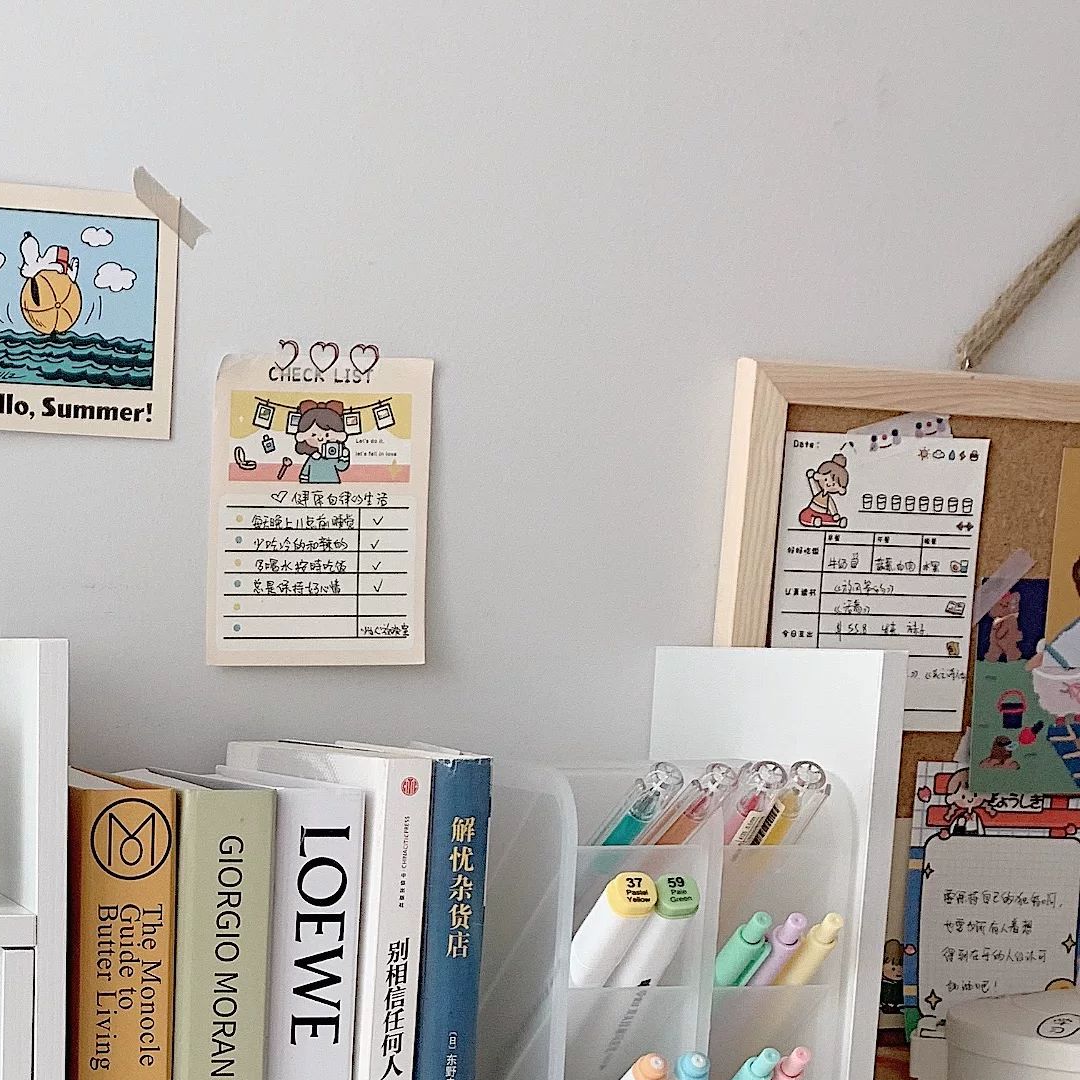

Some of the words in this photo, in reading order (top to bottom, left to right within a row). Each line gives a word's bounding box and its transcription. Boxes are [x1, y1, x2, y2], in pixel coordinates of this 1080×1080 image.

[269, 366, 325, 383] CHECK
[334, 367, 374, 384] LIST
[41, 396, 153, 423] Summer!
[793, 439, 820, 450] Date:
[214, 835, 244, 963] GIORGIO
[446, 816, 476, 959] 解忧杂货店
[625, 877, 643, 888] 37
[667, 876, 685, 888] 59
[96, 903, 119, 981] Butter
[118, 903, 141, 978] Guide
[141, 903, 163, 950] The
[290, 825, 351, 1046] LOEWE
[117, 987, 138, 1010] to
[139, 959, 163, 1067] Monocle
[89, 989, 118, 1071] Living
